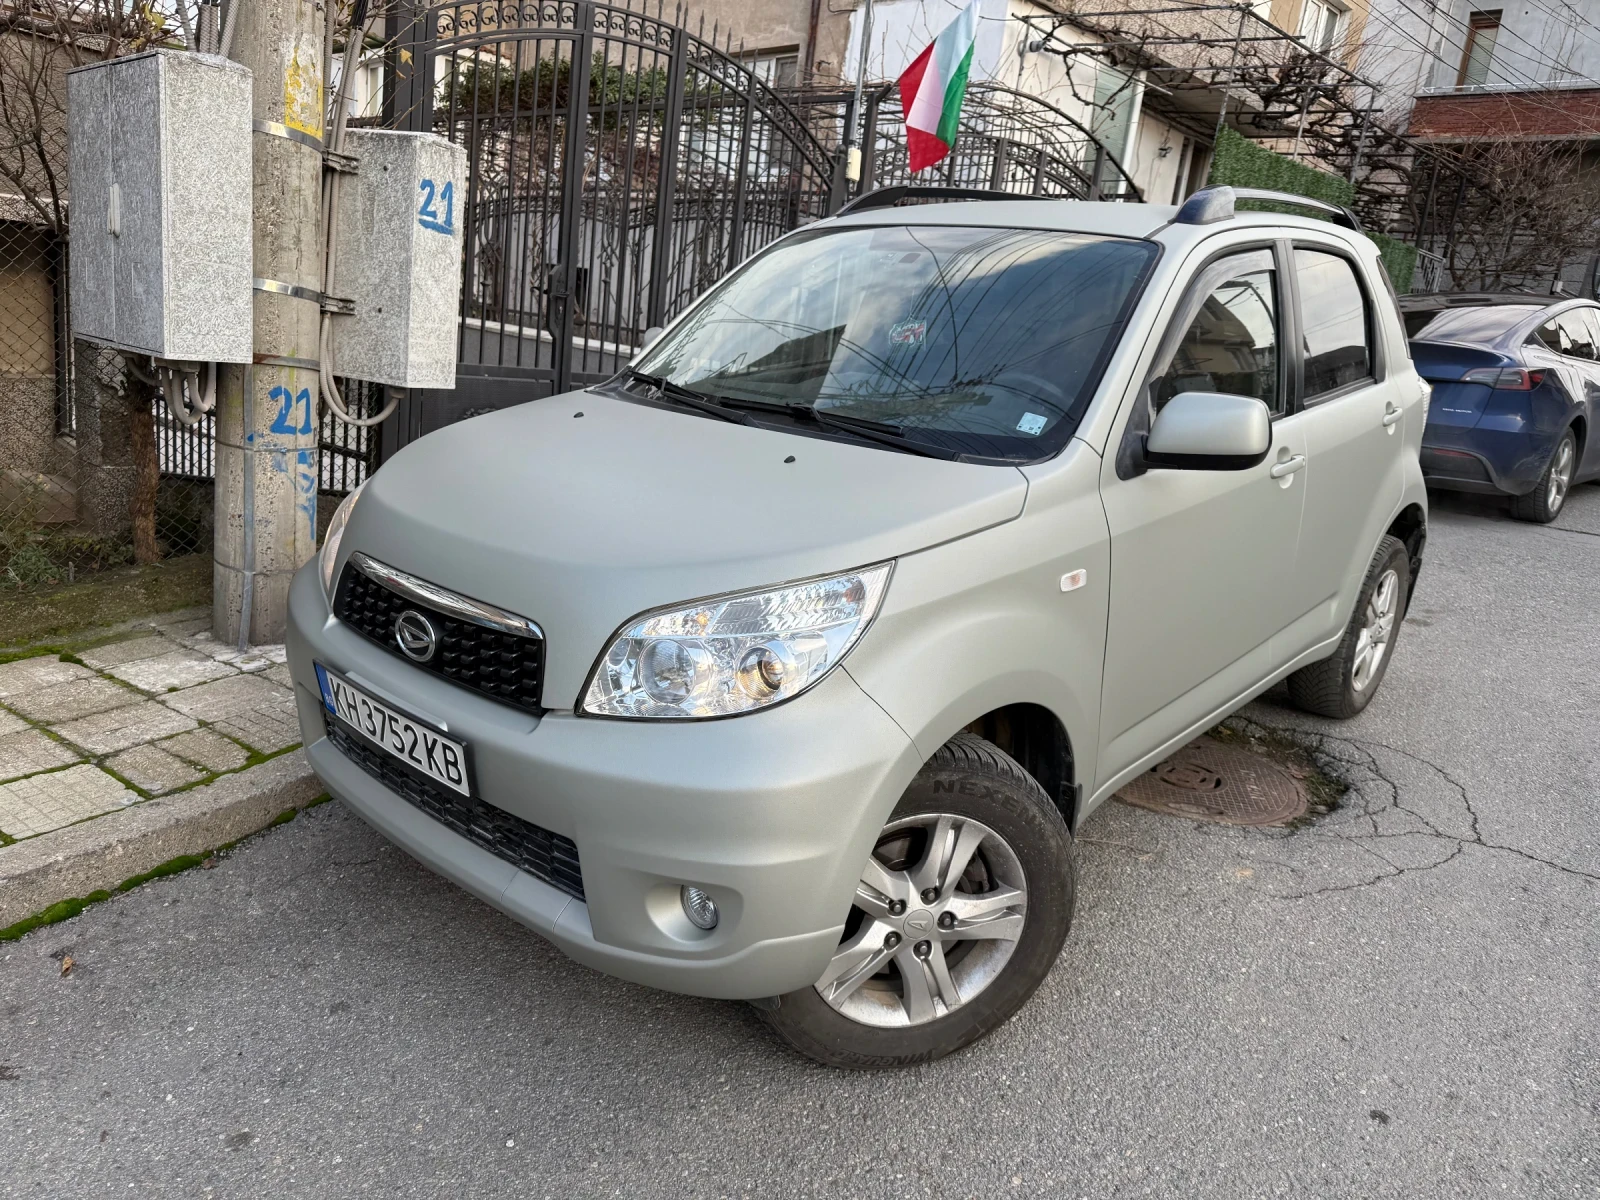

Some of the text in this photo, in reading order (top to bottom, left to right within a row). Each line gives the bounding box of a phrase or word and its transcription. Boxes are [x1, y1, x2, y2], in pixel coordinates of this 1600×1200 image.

[419, 179, 453, 228] 21
[268, 385, 312, 435] 21
[330, 677, 463, 786] KH3752KB
[933, 779, 1038, 825] NEXEN
[830, 1048, 934, 1067] WINGUARD
